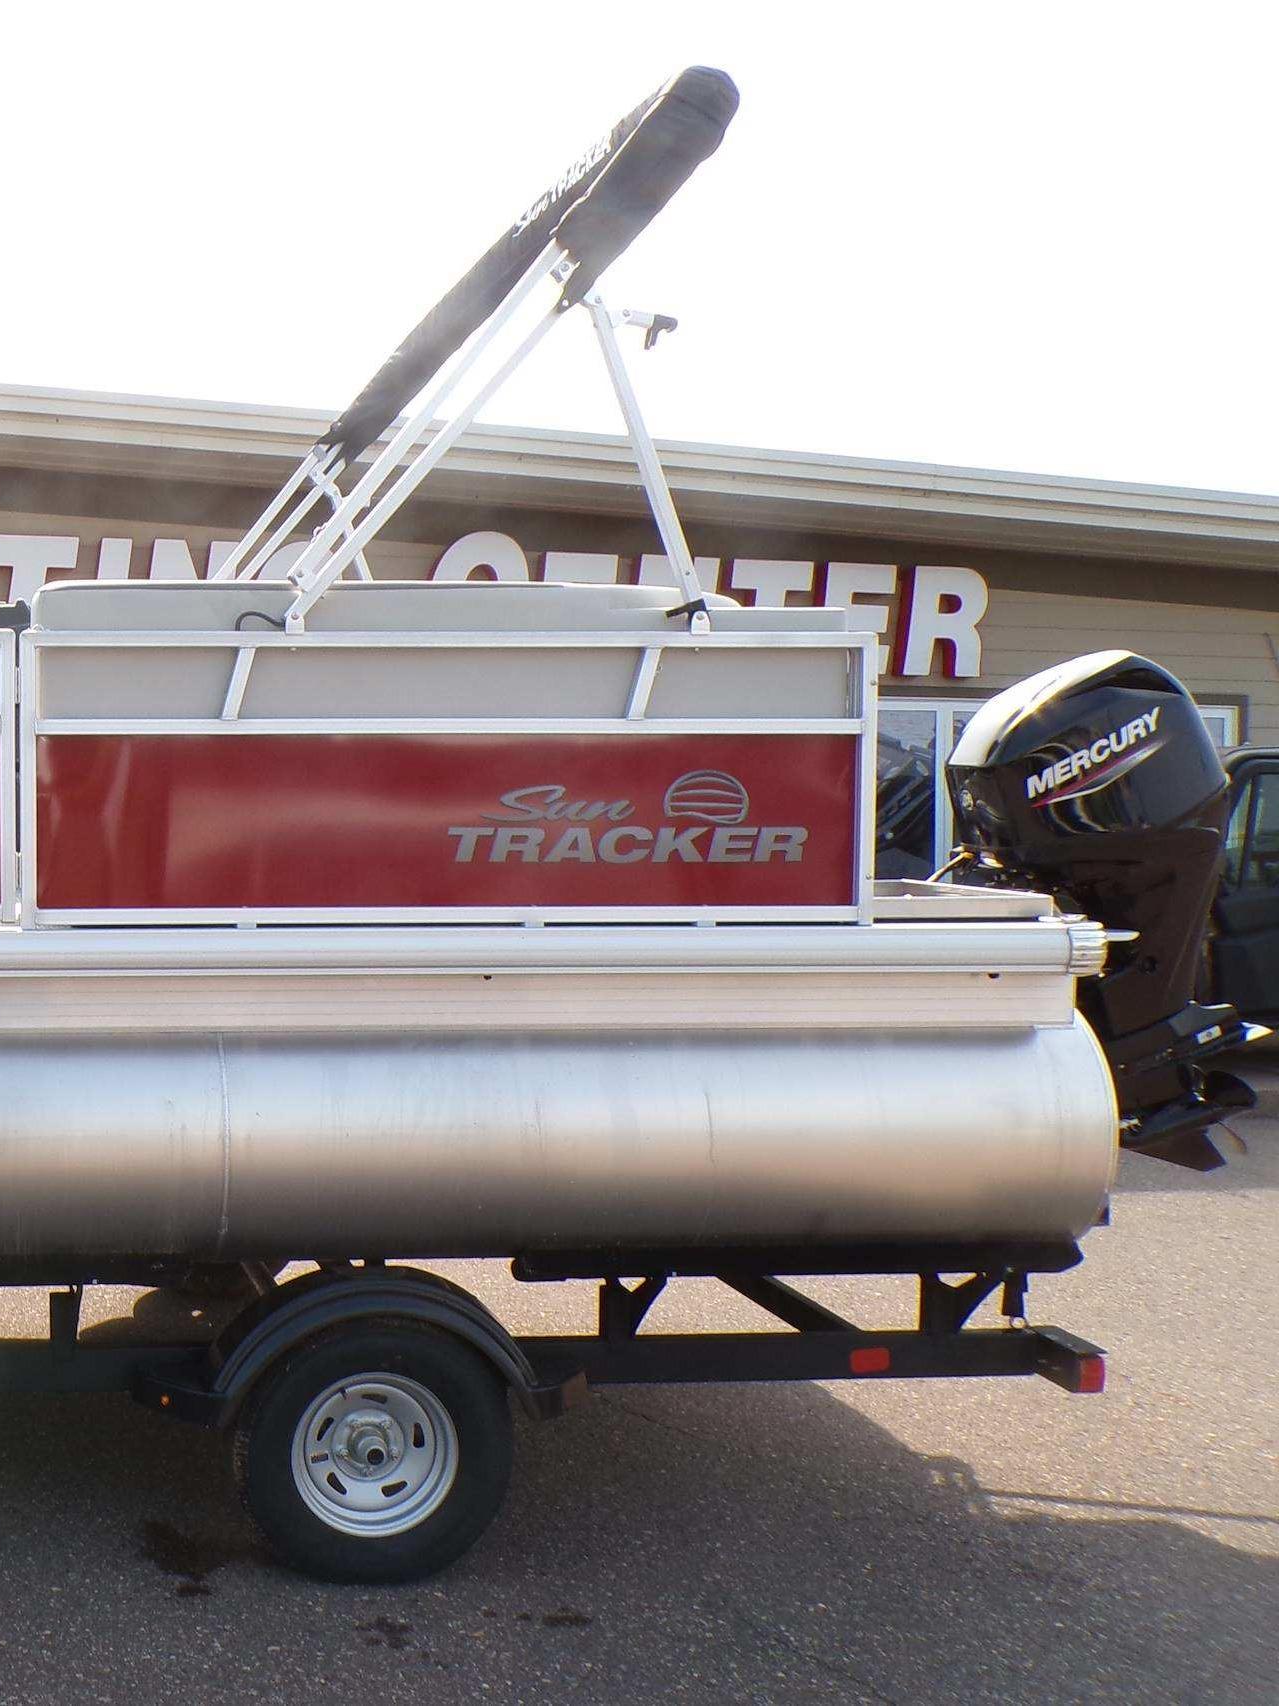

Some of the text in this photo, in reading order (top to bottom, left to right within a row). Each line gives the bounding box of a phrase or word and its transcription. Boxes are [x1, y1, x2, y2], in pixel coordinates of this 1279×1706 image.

[1026, 706, 1163, 799] MERCURY
[480, 784, 636, 822] Sun
[447, 826, 809, 864] TRACKER
